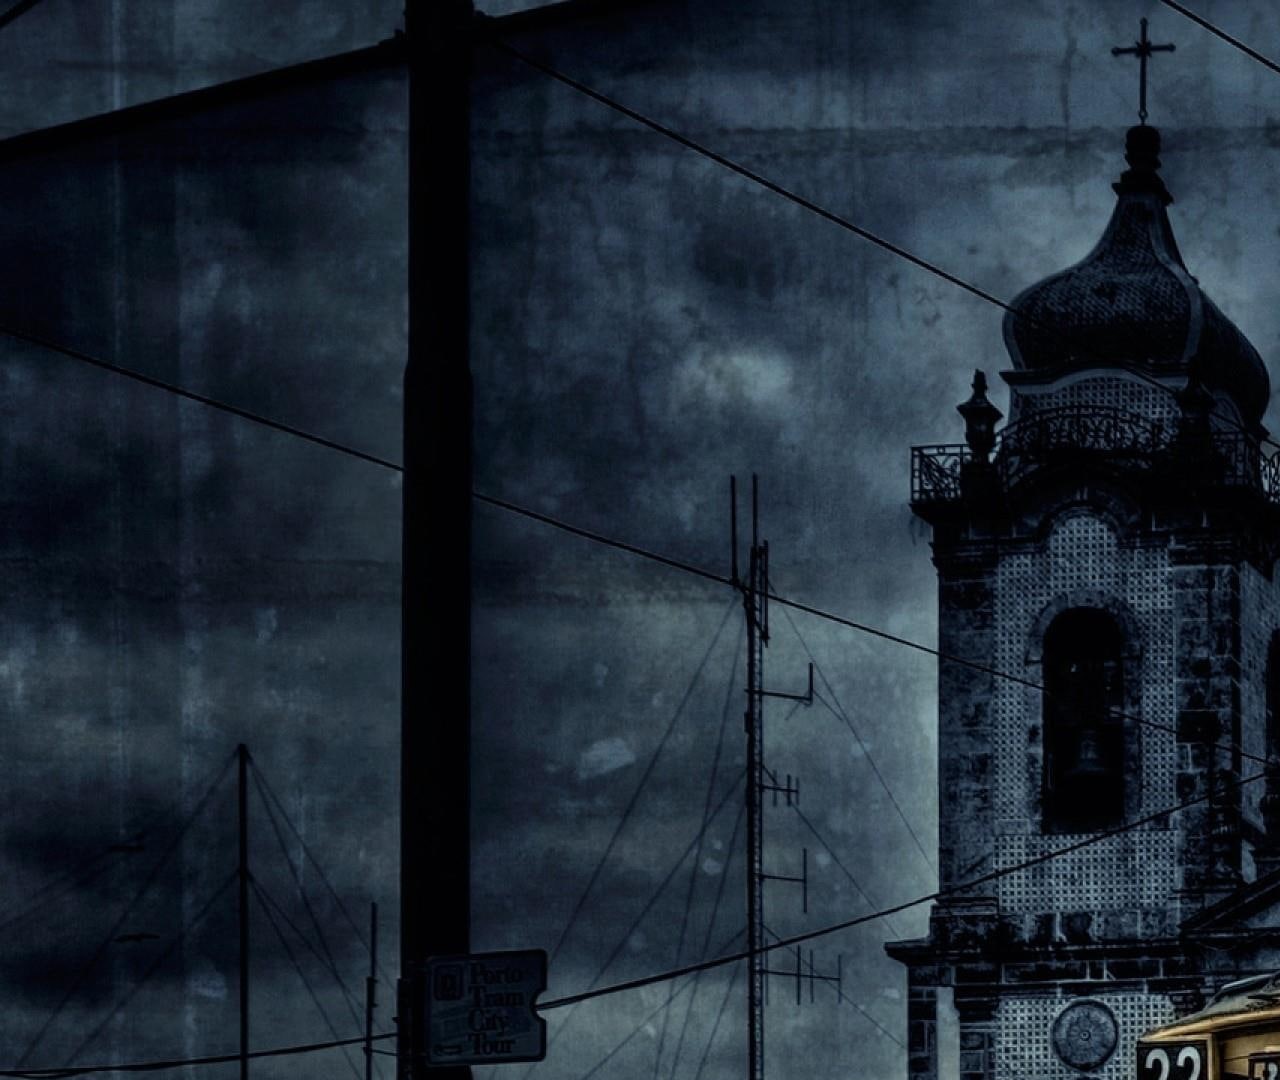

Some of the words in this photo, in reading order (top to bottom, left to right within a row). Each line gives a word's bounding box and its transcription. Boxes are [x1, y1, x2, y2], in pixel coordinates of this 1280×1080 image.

[469, 962, 523, 985] Porto
[468, 985, 524, 1007] Tram
[468, 1008, 509, 1037] City
[468, 1033, 516, 1055] Tour
